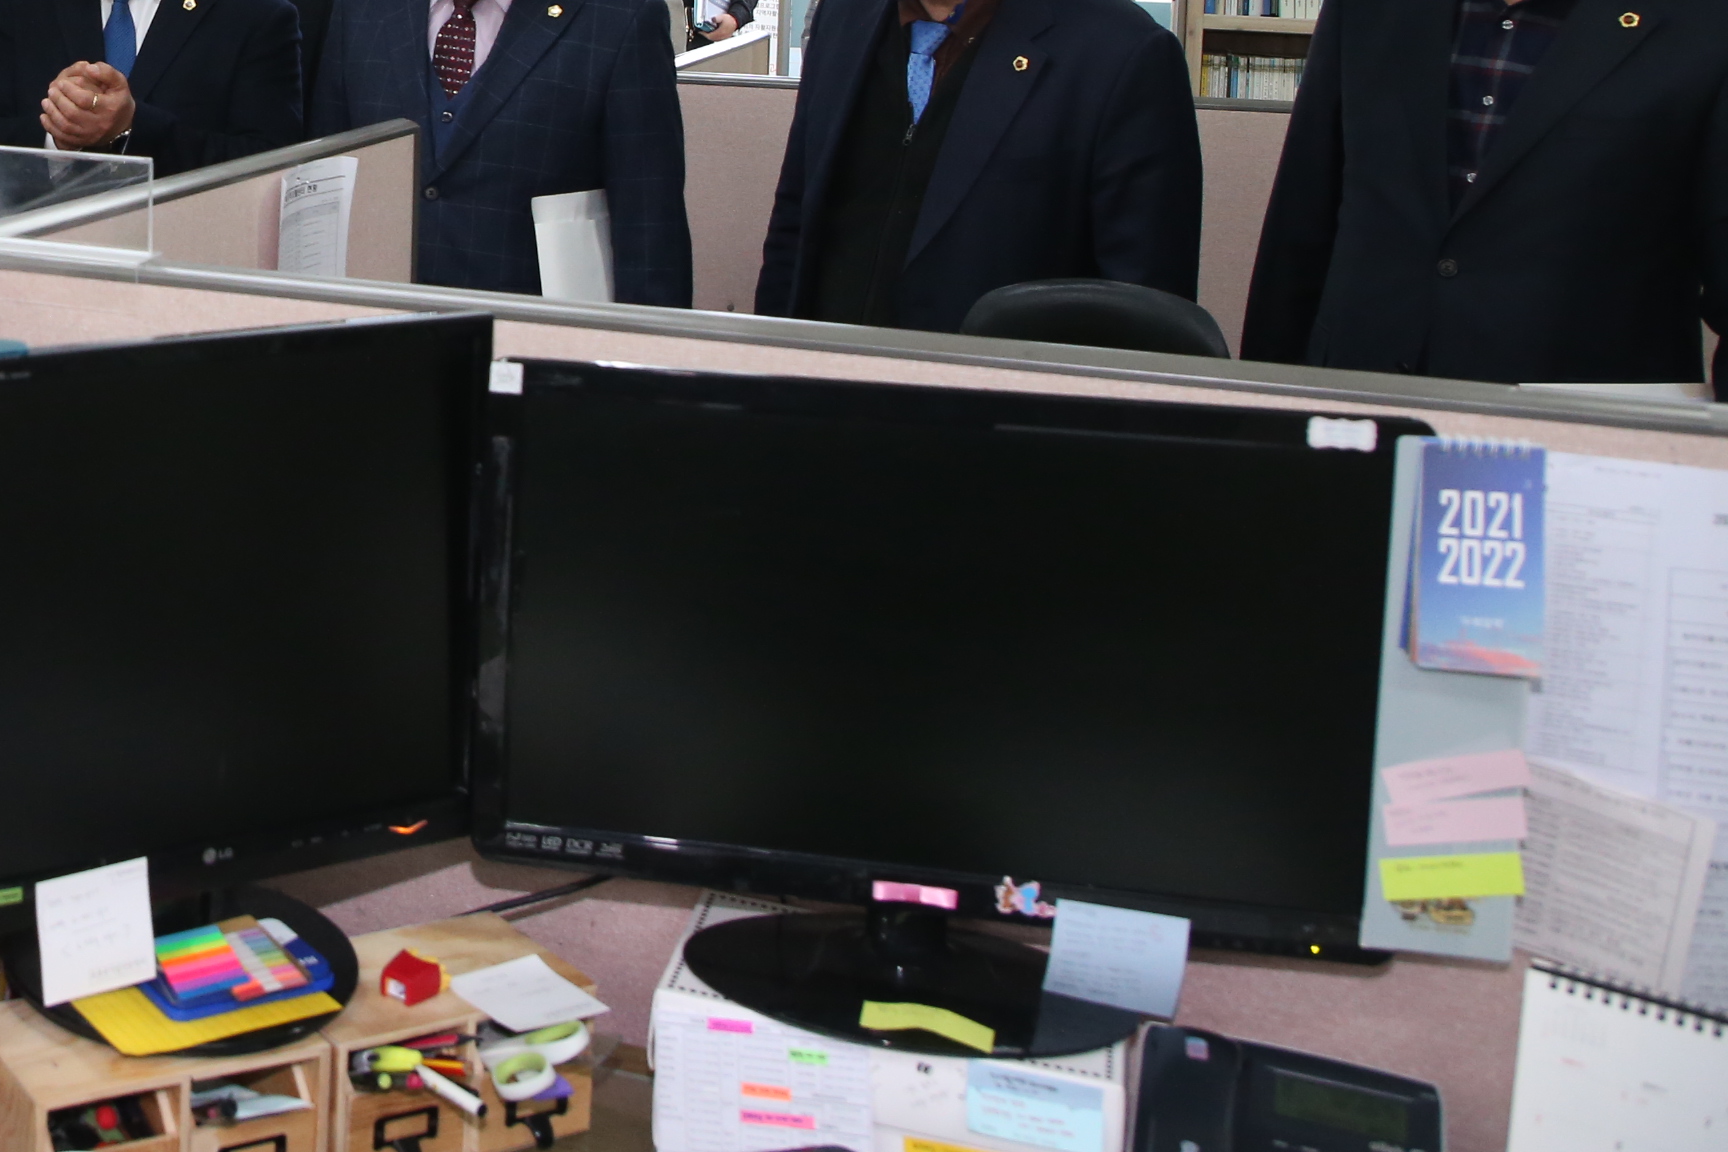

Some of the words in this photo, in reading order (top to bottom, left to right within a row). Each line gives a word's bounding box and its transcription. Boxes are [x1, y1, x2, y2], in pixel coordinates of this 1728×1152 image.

[1438, 489, 1523, 539] 2021
[1437, 538, 1526, 588] 2022
[218, 848, 233, 860] LG
